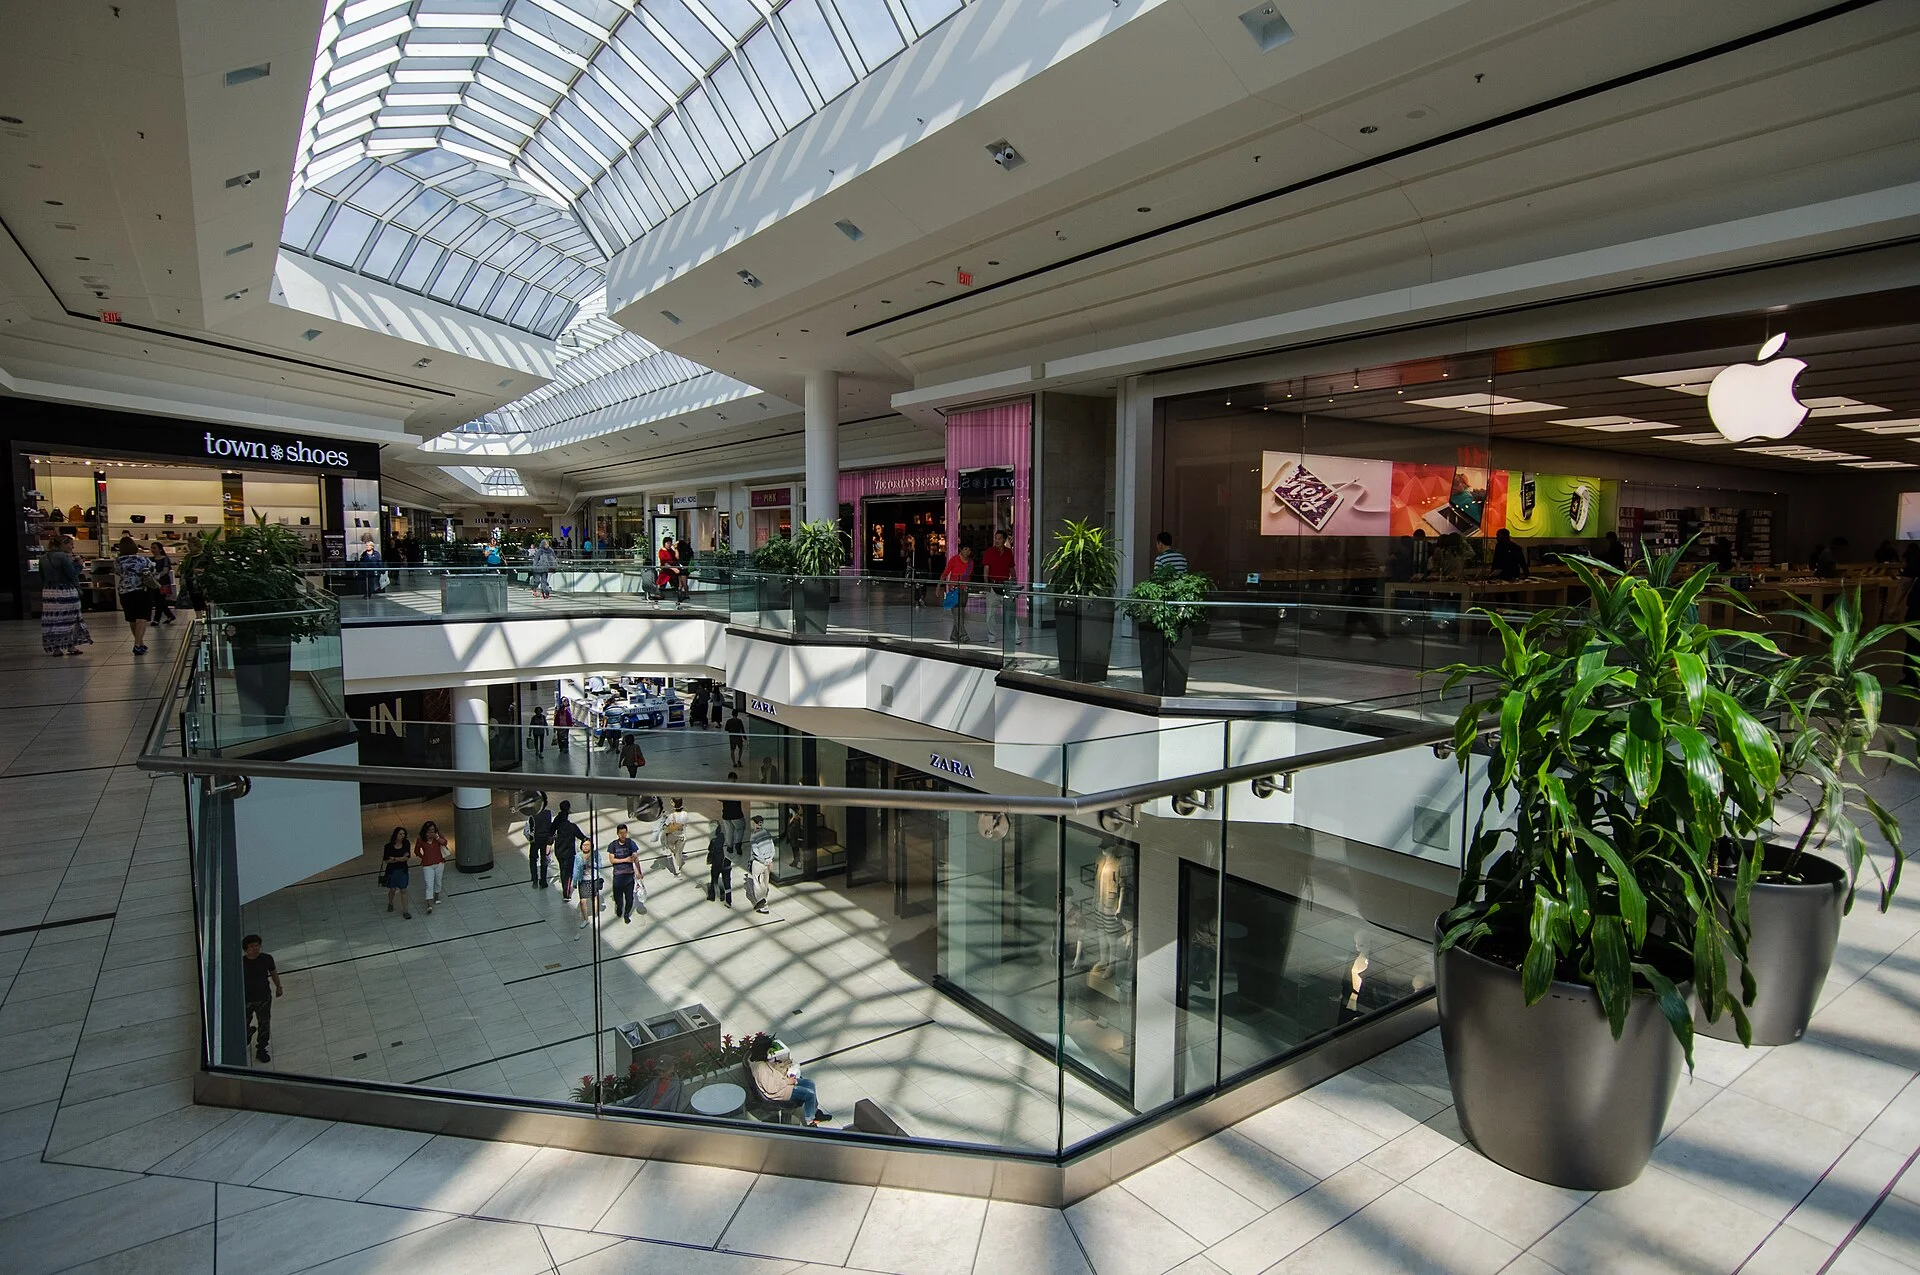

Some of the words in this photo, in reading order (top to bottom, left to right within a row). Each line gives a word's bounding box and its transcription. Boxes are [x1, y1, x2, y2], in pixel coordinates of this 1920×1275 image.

[204, 432, 268, 459] town
[287, 441, 349, 467] shoes
[763, 493, 777, 502] PINK
[370, 698, 402, 737] IN
[751, 699, 777, 716] ZARA
[930, 753, 975, 779] ZARA
